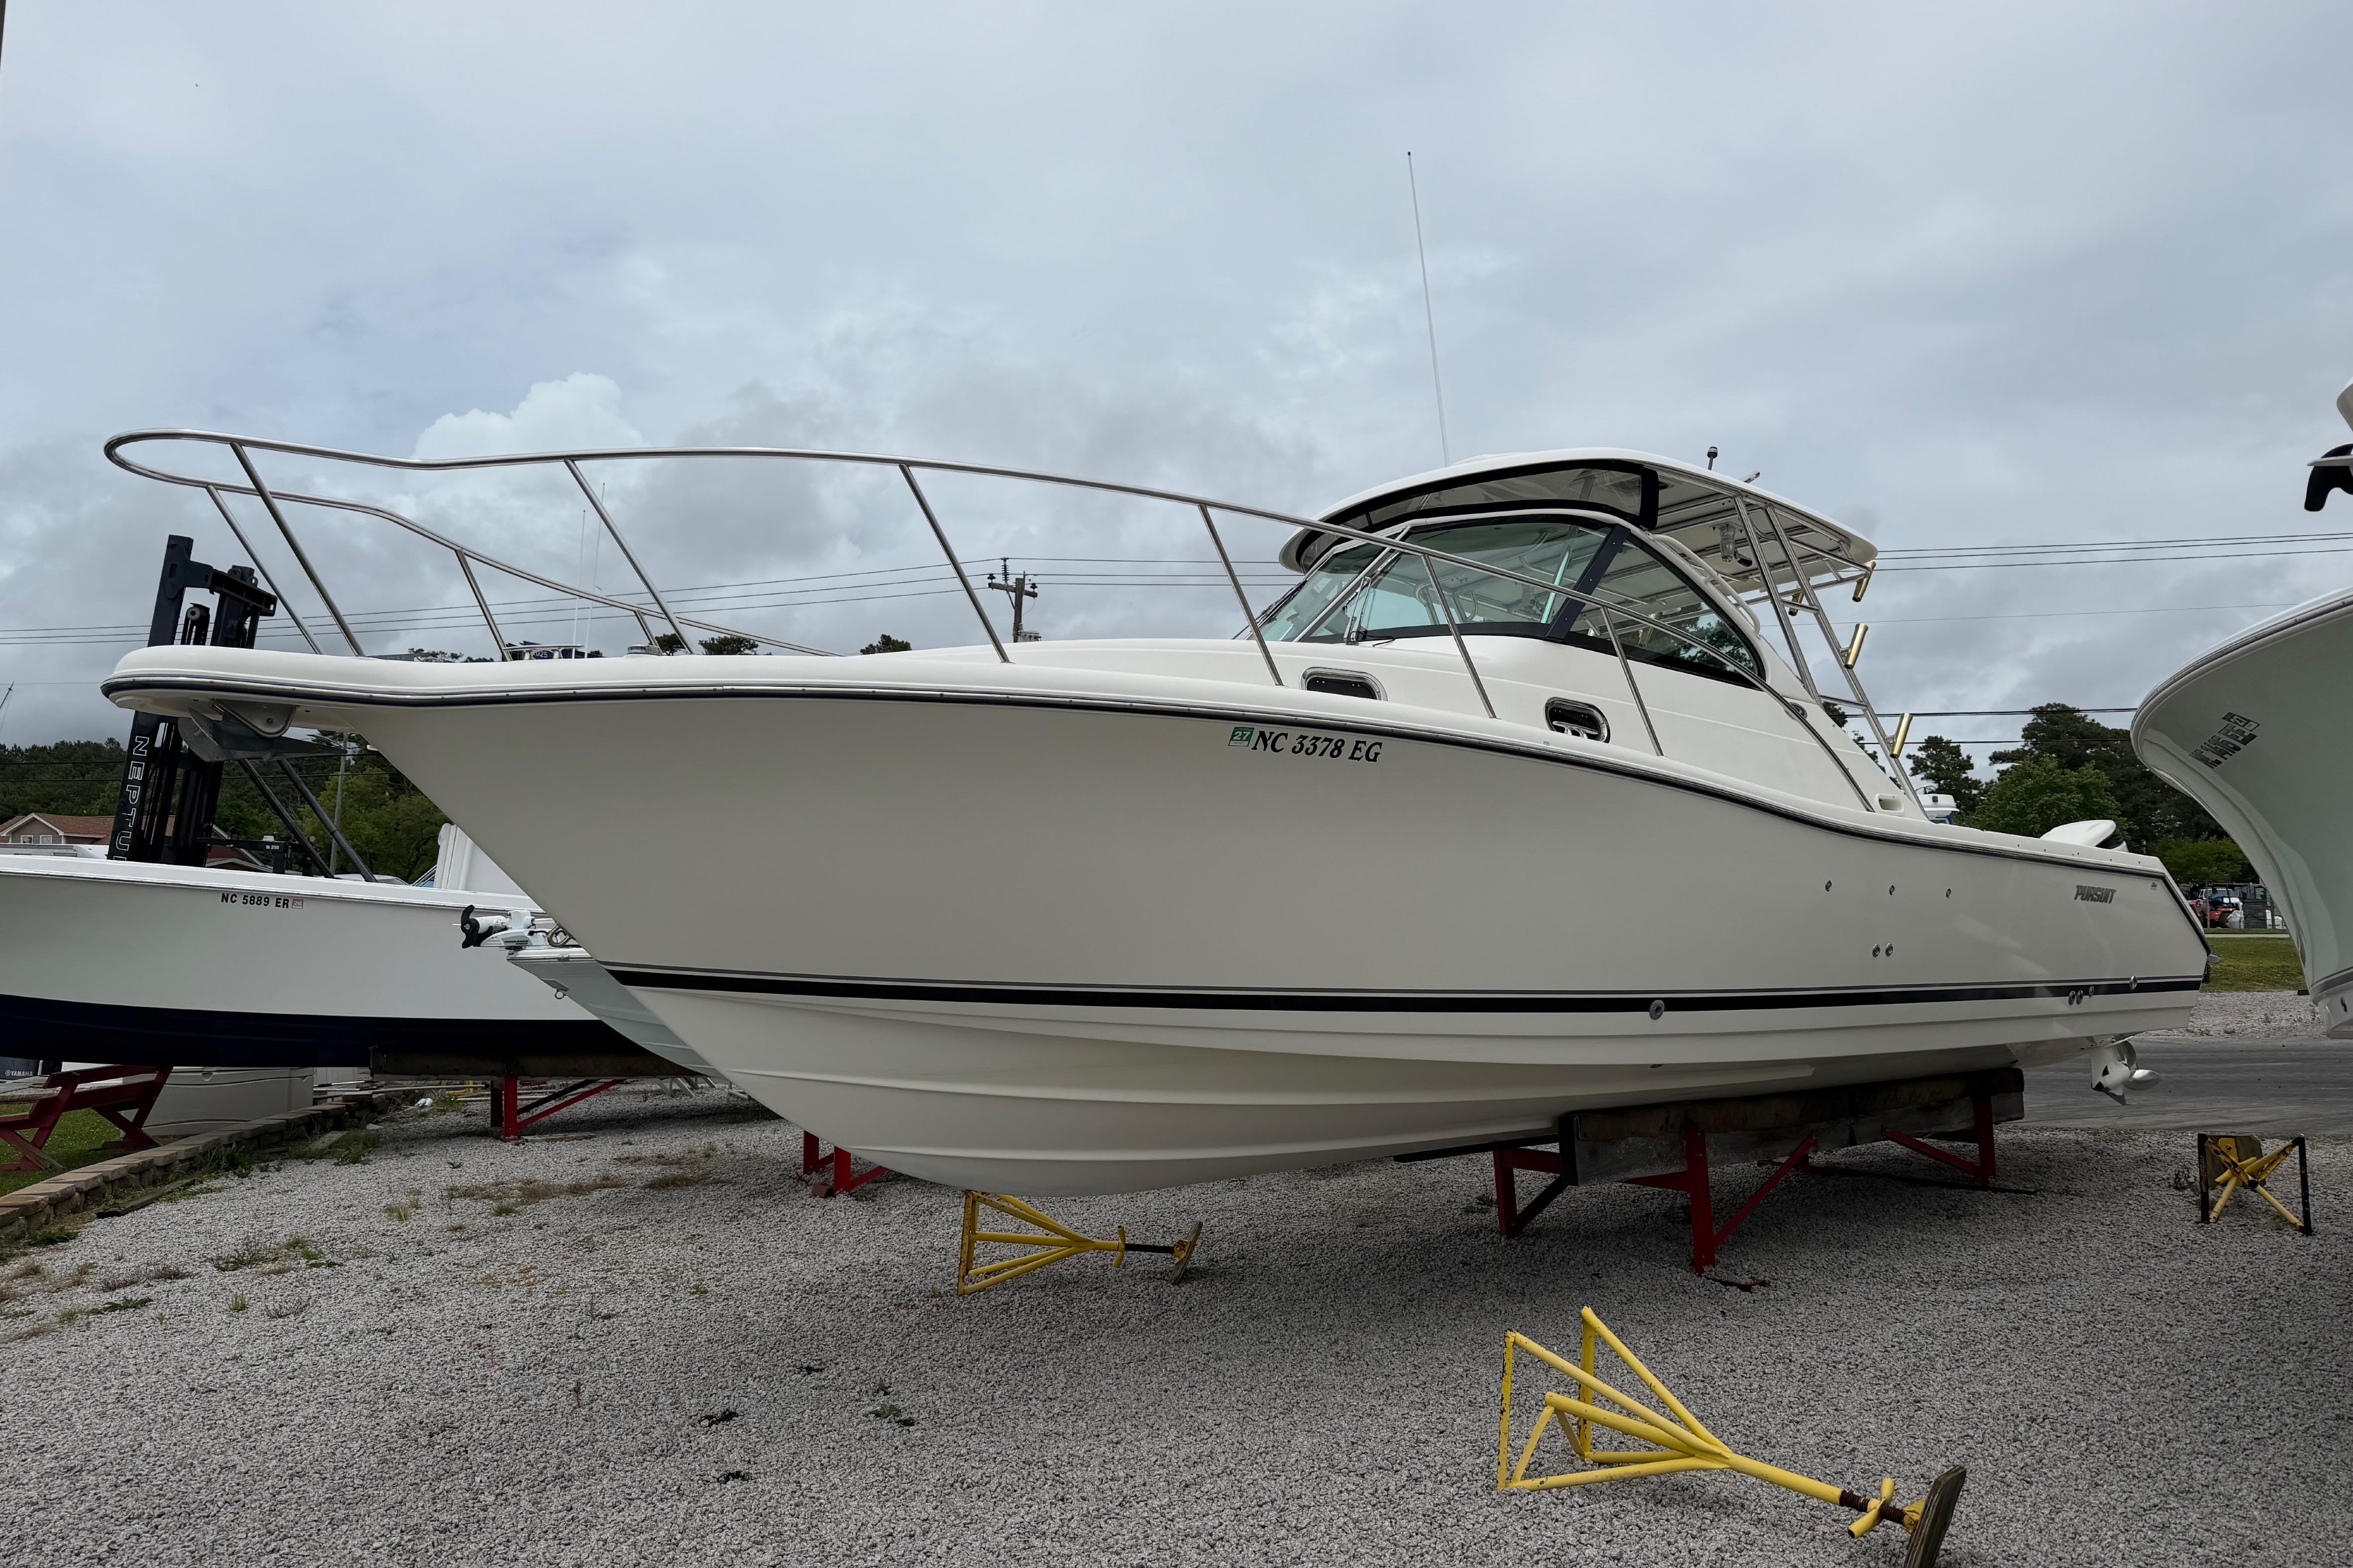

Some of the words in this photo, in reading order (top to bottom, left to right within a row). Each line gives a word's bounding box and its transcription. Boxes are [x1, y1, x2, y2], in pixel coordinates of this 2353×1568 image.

[1233, 731, 1251, 740] 27
[1251, 730, 1288, 752] NC
[1292, 734, 1345, 758] 3378
[1347, 740, 1383, 762] EG
[2189, 749, 2222, 769] NC
[2218, 723, 2257, 746] EE
[221, 892, 237, 903] NC
[242, 895, 270, 906] 5889
[275, 897, 290, 908] ER
[2074, 884, 2117, 903] PURSUIT
